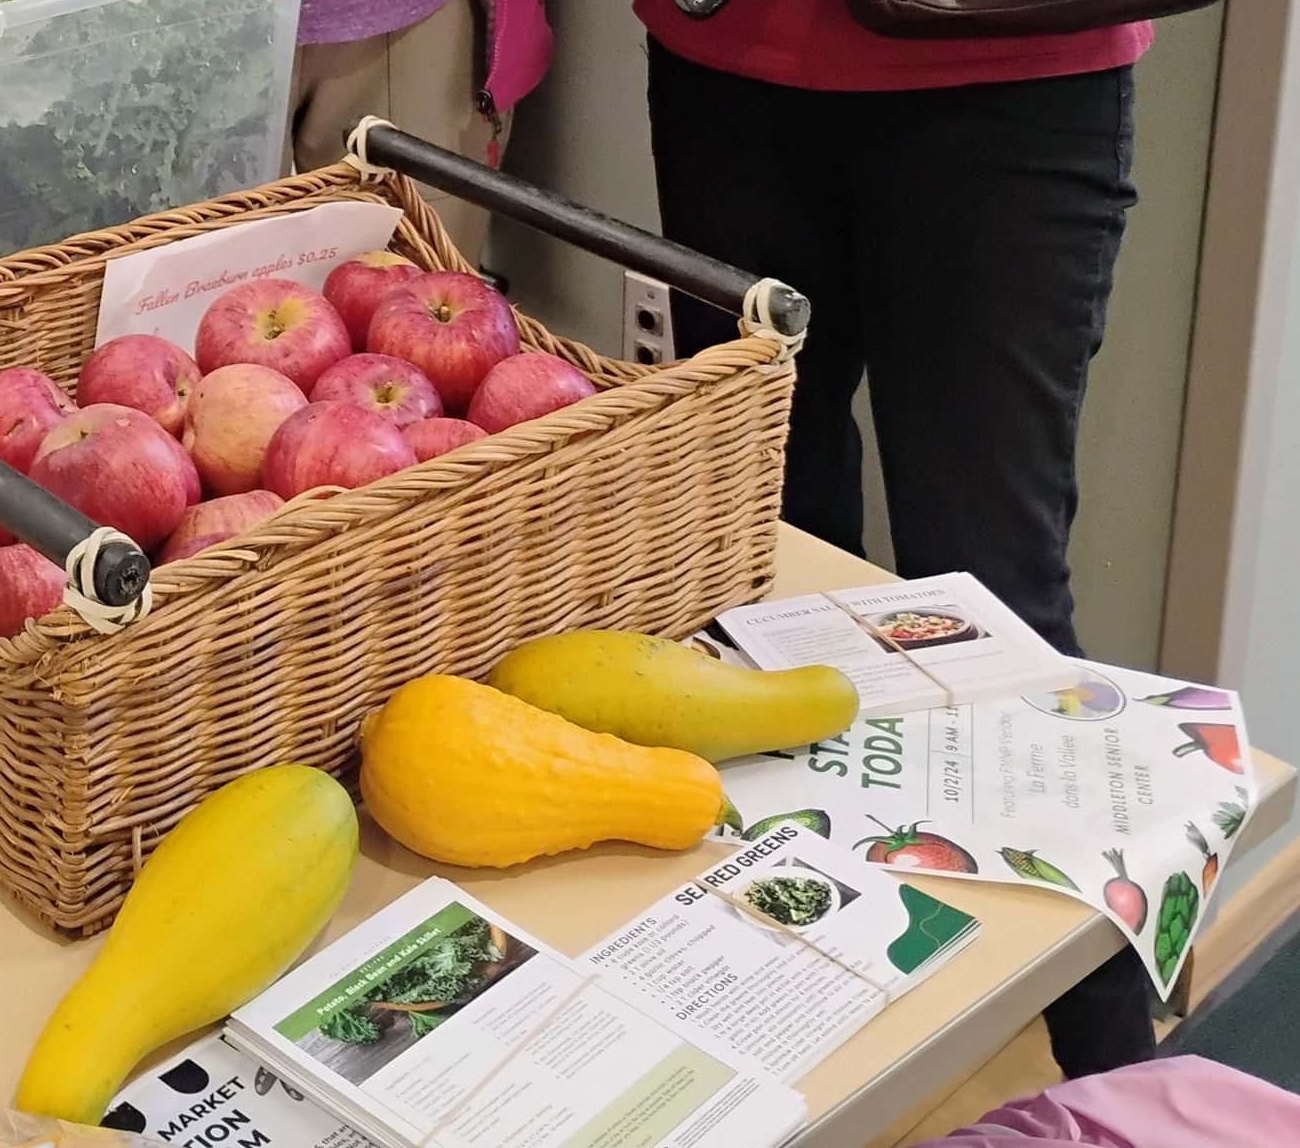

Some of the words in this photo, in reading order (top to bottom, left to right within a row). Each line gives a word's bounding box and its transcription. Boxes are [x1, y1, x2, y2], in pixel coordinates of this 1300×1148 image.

[134, 288, 179, 315] Fallen
[183, 269, 250, 301] Braeburn
[251, 253, 293, 281] apples
[297, 247, 338, 266] $0.25
[746, 607, 812, 626] CUCUMBER
[811, 600, 851, 615] SALD
[852, 596, 883, 611] WITH
[883, 588, 946, 604] TOMATOES
[861, 718, 904, 789] TODA
[945, 727, 959, 743] AM
[946, 743, 958, 752] 9
[1057, 735, 1077, 768] Vallee
[1104, 728, 1123, 767] SENIOR
[944, 760, 963, 802] 10/2/24
[1026, 744, 1044, 778] Ferme
[1058, 771, 1077, 781] la
[1027, 779, 1045, 793] La
[1061, 785, 1080, 809] dans
[1108, 772, 1130, 835] MIDDLETON
[1134, 765, 1153, 805] CENTER
[736, 826, 799, 868] GREENS
[589, 917, 657, 965] INGREDIENTS
[316, 995, 348, 1015] Potato,
[345, 979, 367, 995] Black
[365, 966, 387, 981] Bean
[386, 954, 401, 967] and
[399, 944, 418, 957] Kale
[416, 928, 441, 946] Skillet
[676, 973, 738, 1020] DIRECTIONS
[156, 1076, 245, 1141] MARKET
